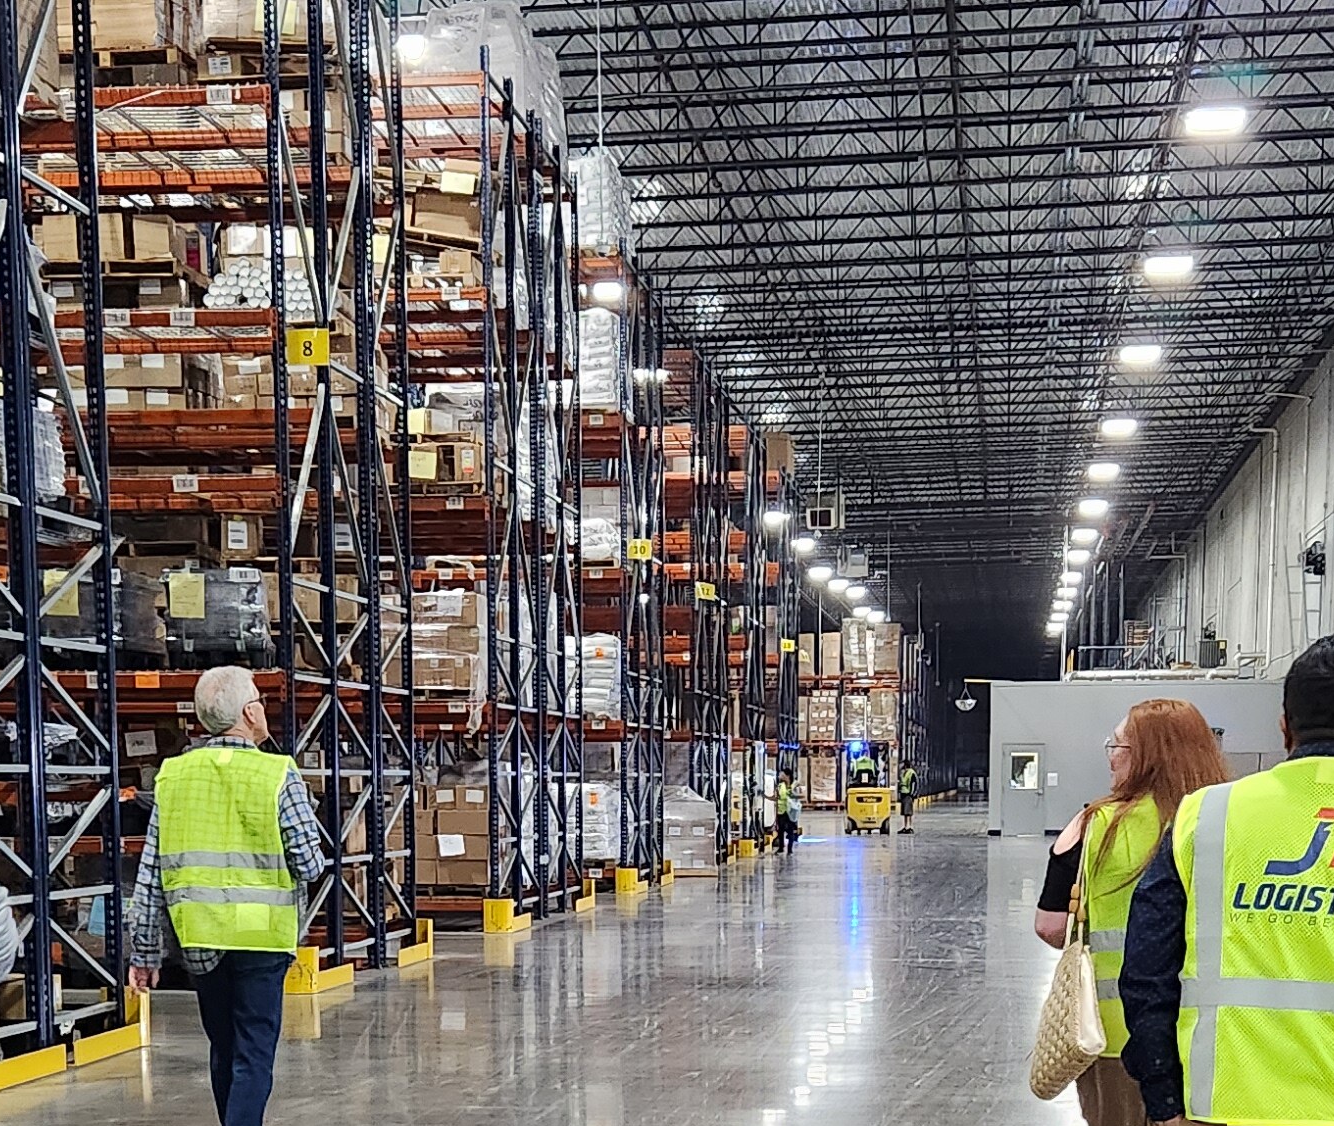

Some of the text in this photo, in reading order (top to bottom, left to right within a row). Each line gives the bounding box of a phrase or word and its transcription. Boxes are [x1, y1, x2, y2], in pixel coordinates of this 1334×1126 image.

[302, 340, 313, 357] 8
[633, 545, 646, 555] 10
[1229, 912, 1255, 924] WE
[1268, 914, 1294, 925] GO
